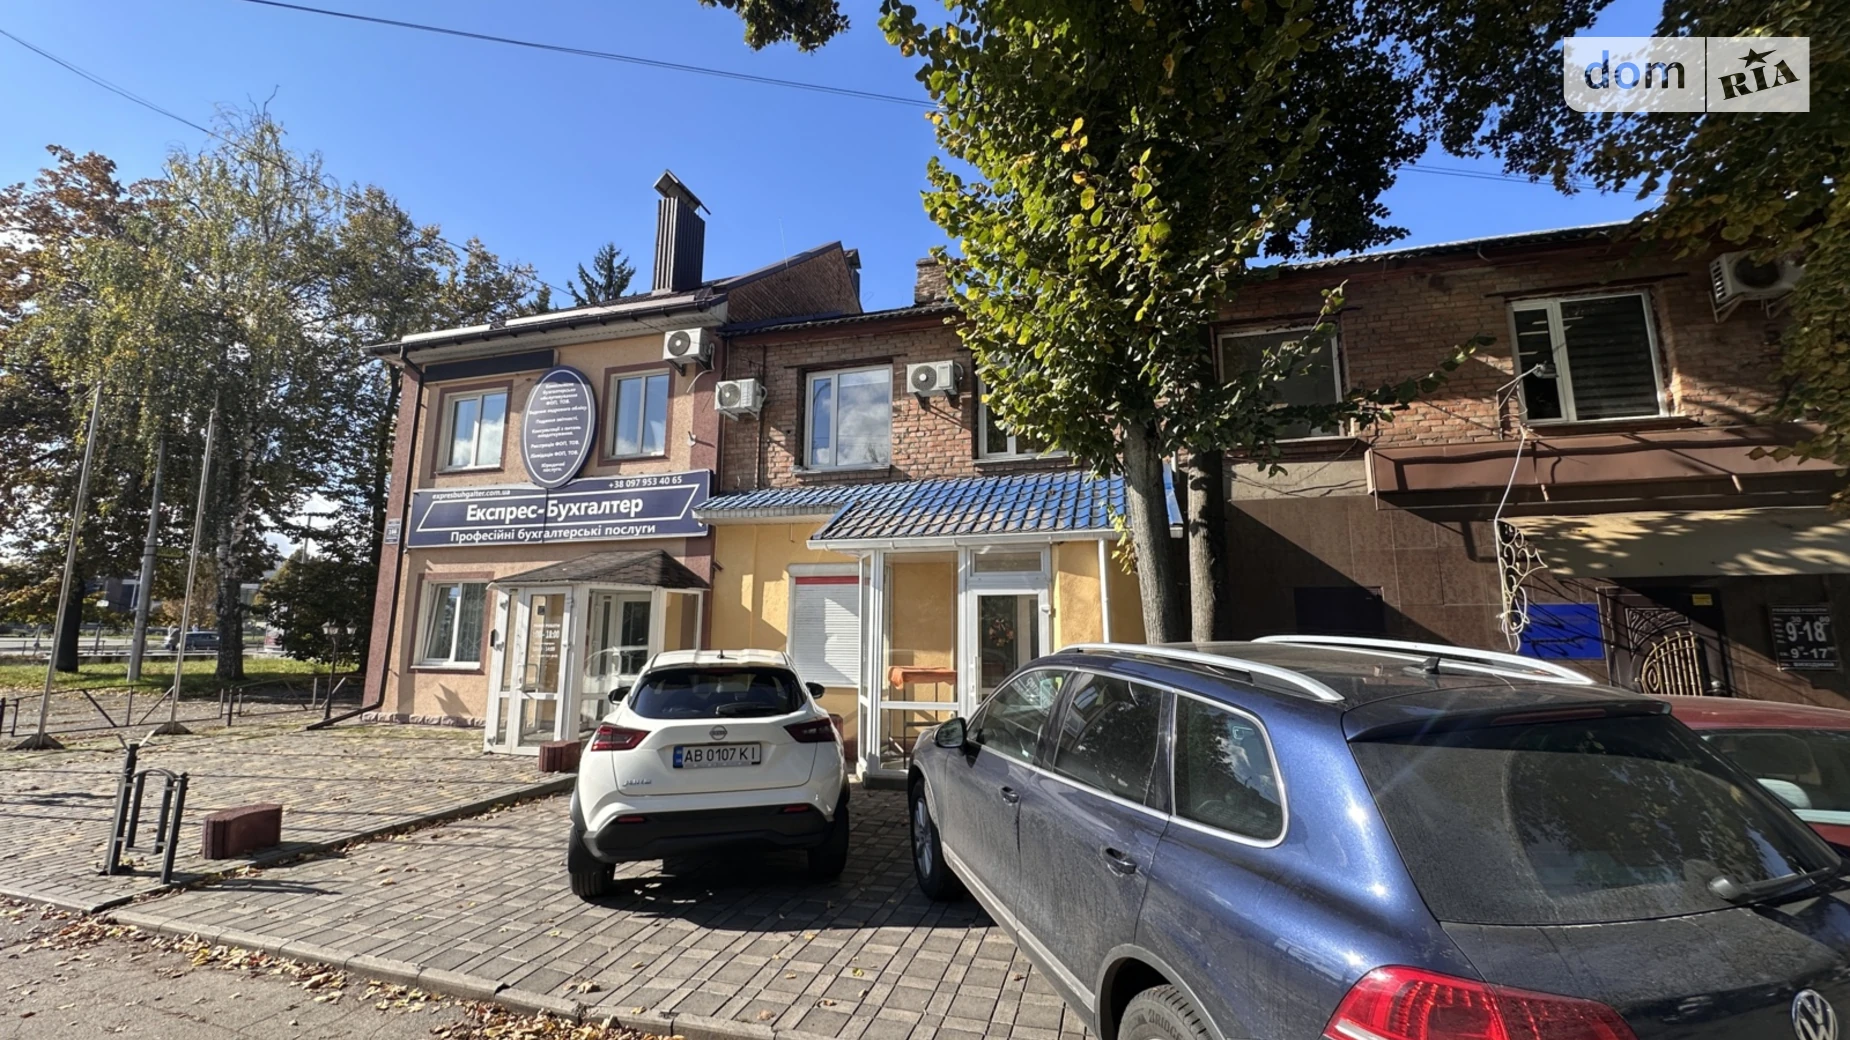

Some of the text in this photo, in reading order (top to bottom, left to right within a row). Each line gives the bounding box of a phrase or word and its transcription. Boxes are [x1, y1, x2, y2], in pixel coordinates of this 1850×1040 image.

[608, 475, 683, 489] +38 097 953 40 65
[432, 489, 511, 500] expresbuhgalter.com.ua
[466, 498, 644, 524] Експрес-Бухгалтер
[450, 525, 656, 544] Професійні бухгалтерські послуги
[684, 752, 703, 762] AB
[706, 748, 736, 762] 0107
